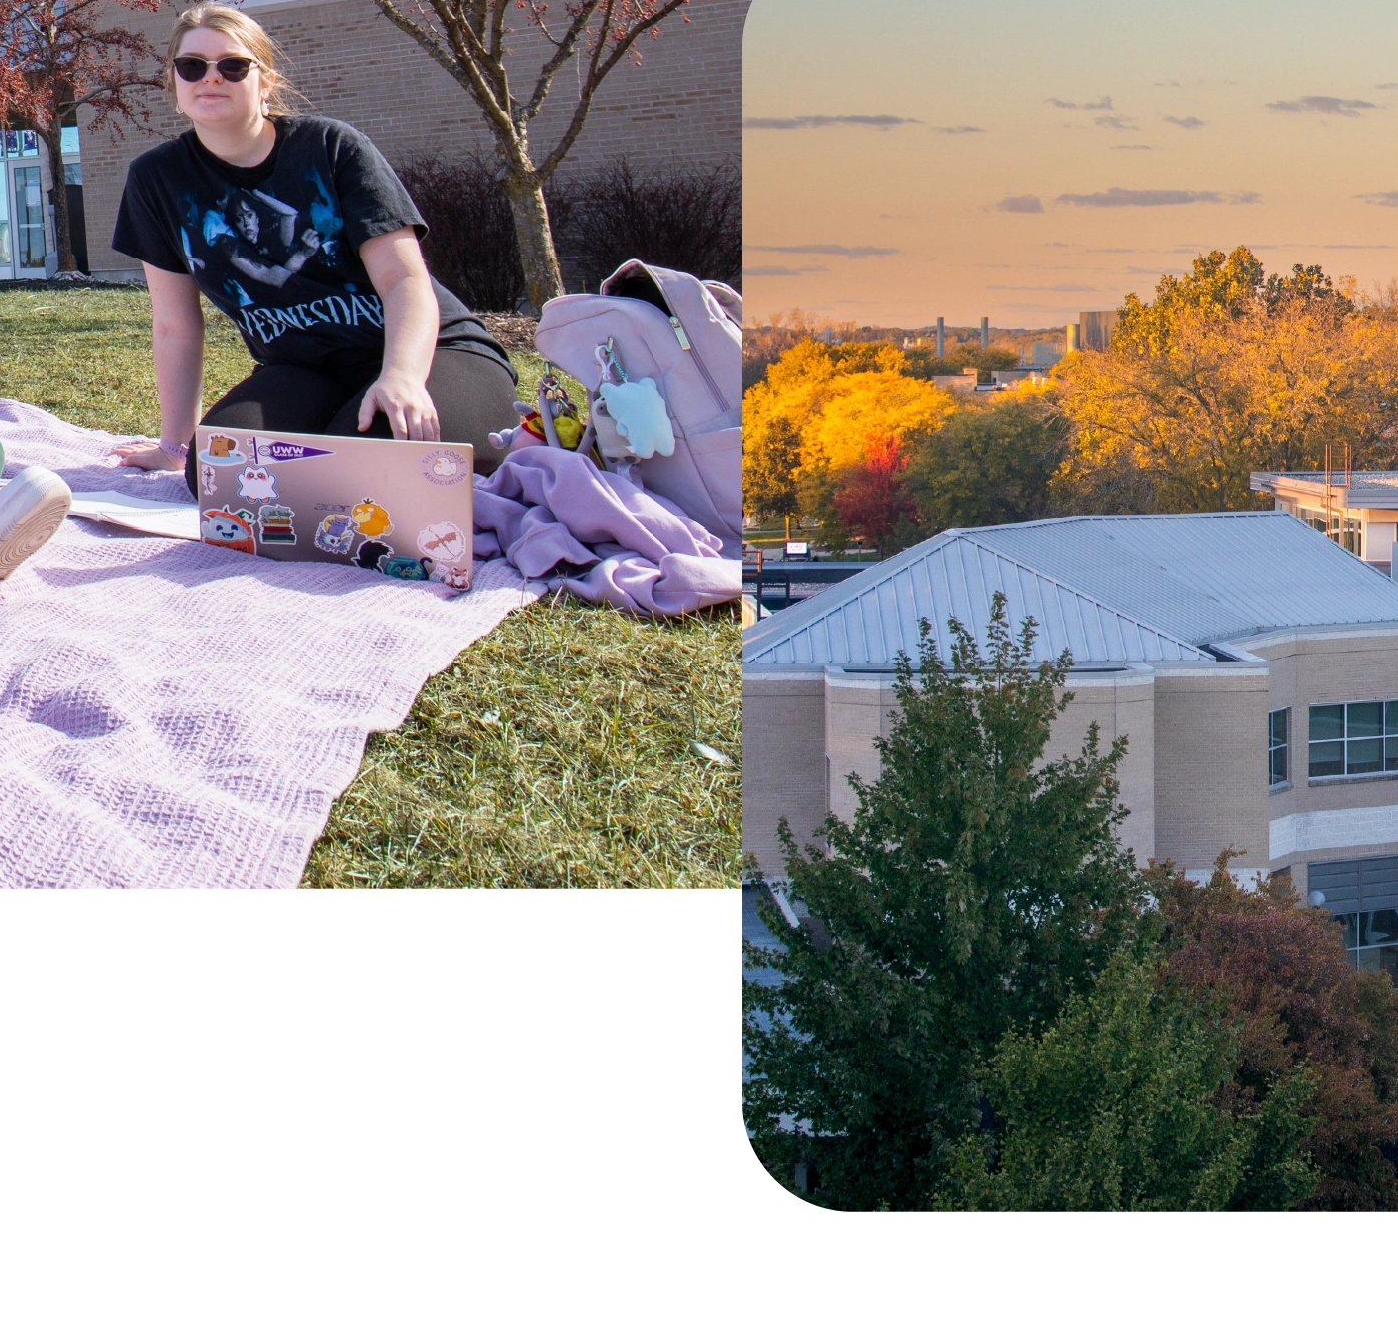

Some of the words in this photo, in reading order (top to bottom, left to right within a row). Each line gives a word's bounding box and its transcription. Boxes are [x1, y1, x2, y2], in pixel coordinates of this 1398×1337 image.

[272, 445, 304, 455] UWW
[422, 449, 440, 465] SILLY
[444, 449, 467, 465] GOOSE
[423, 471, 467, 486] ASSOCIATION
[313, 503, 350, 513] acer
